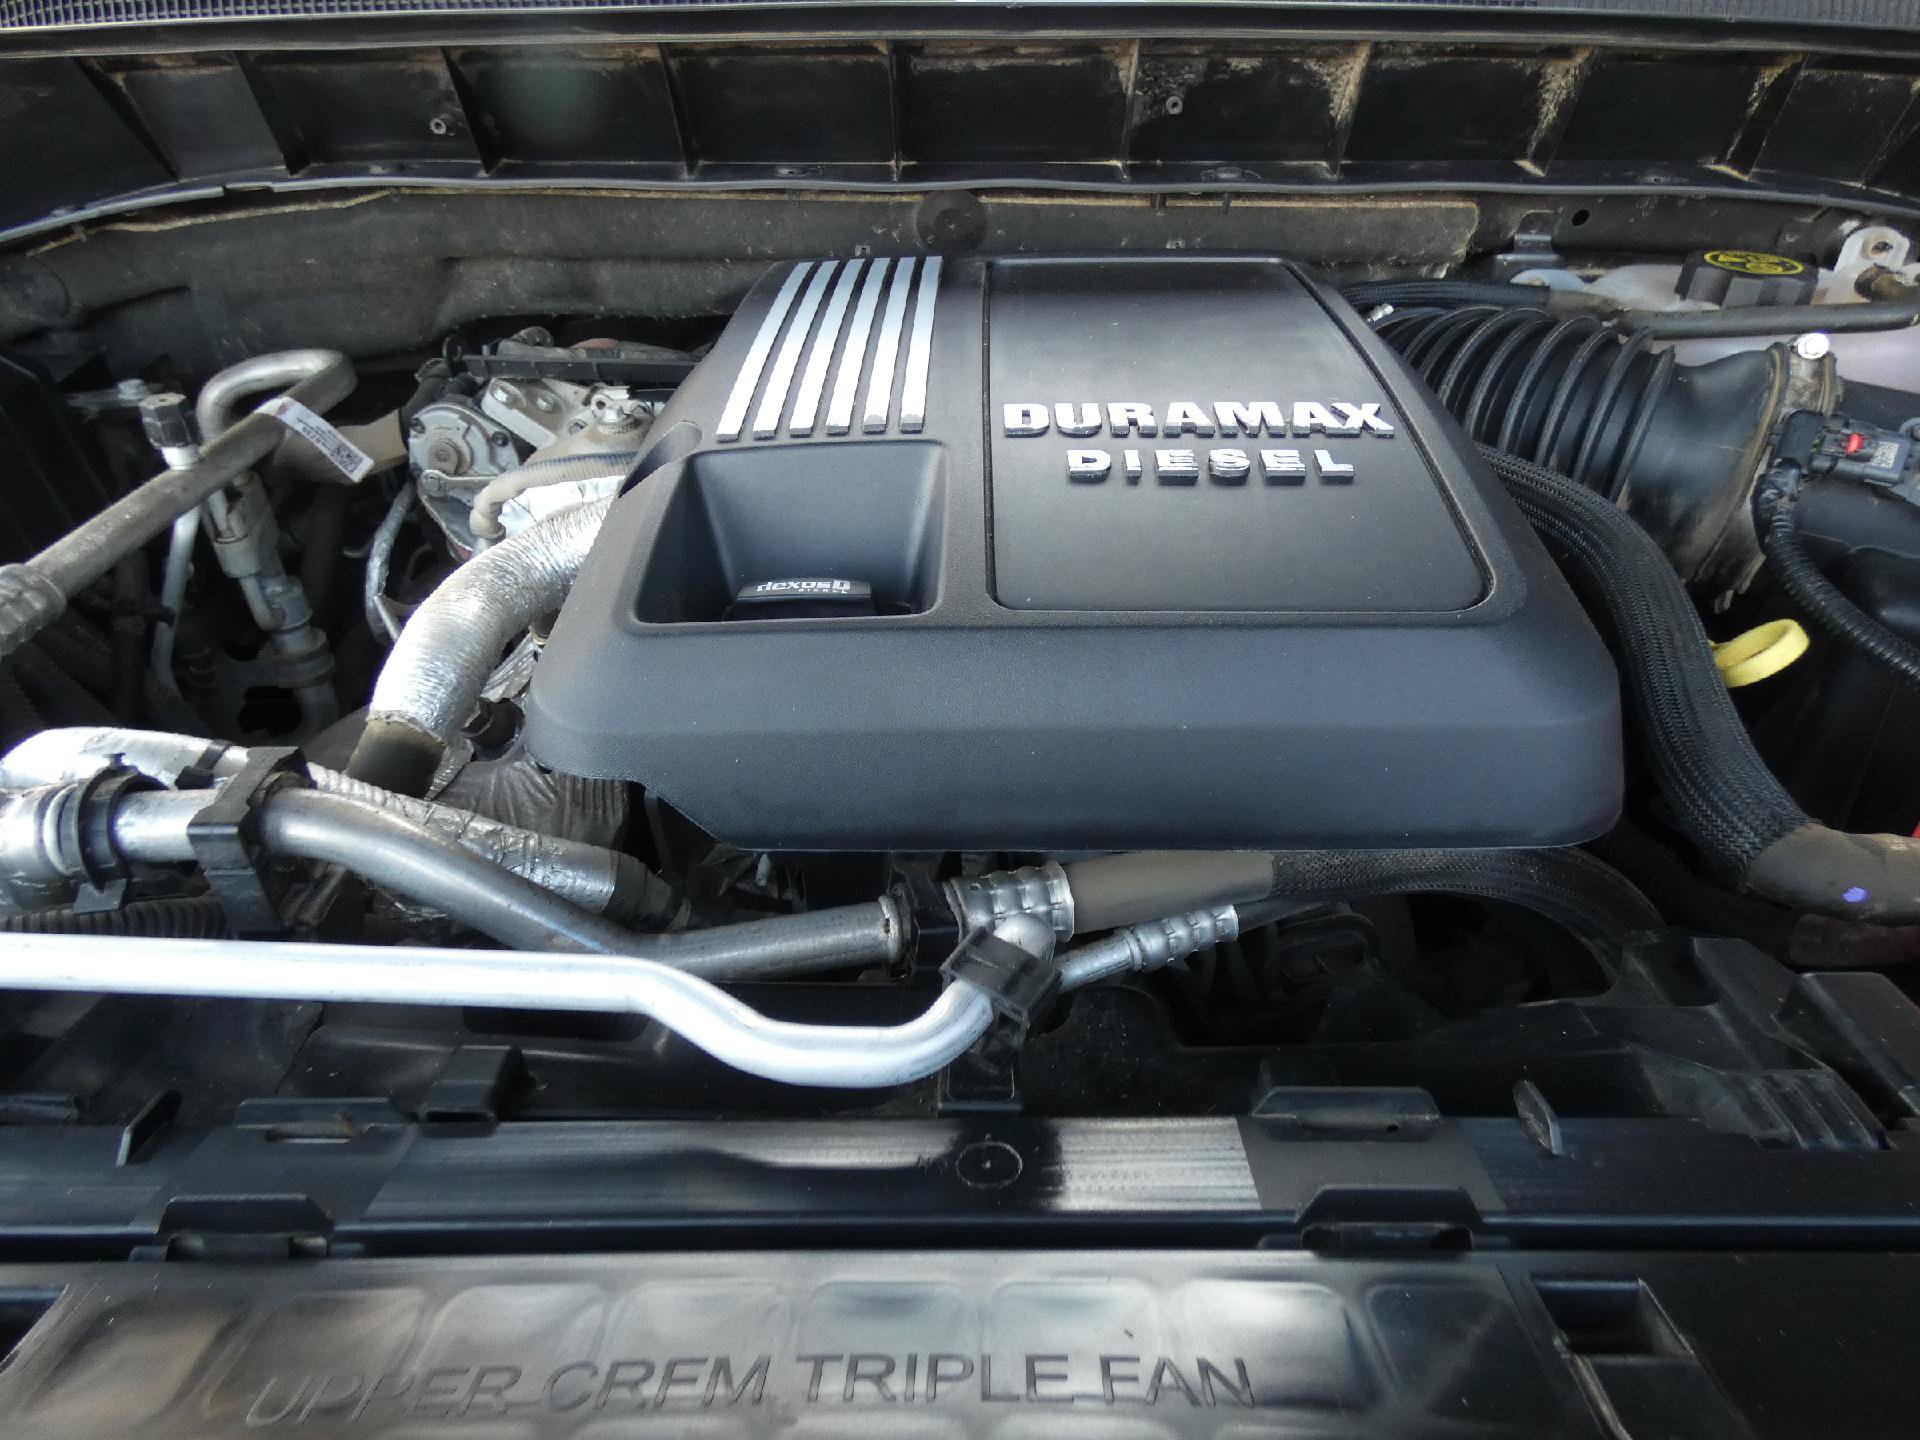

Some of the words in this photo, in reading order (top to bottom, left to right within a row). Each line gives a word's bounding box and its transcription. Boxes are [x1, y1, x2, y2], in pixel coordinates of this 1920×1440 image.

[1003, 401, 1395, 438] DURAMAX
[1066, 449, 1355, 480] DIESEL
[245, 1364, 522, 1427] UPPER
[796, 1353, 1075, 1403] TRIPLE
[1099, 1355, 1255, 1409] FAN
